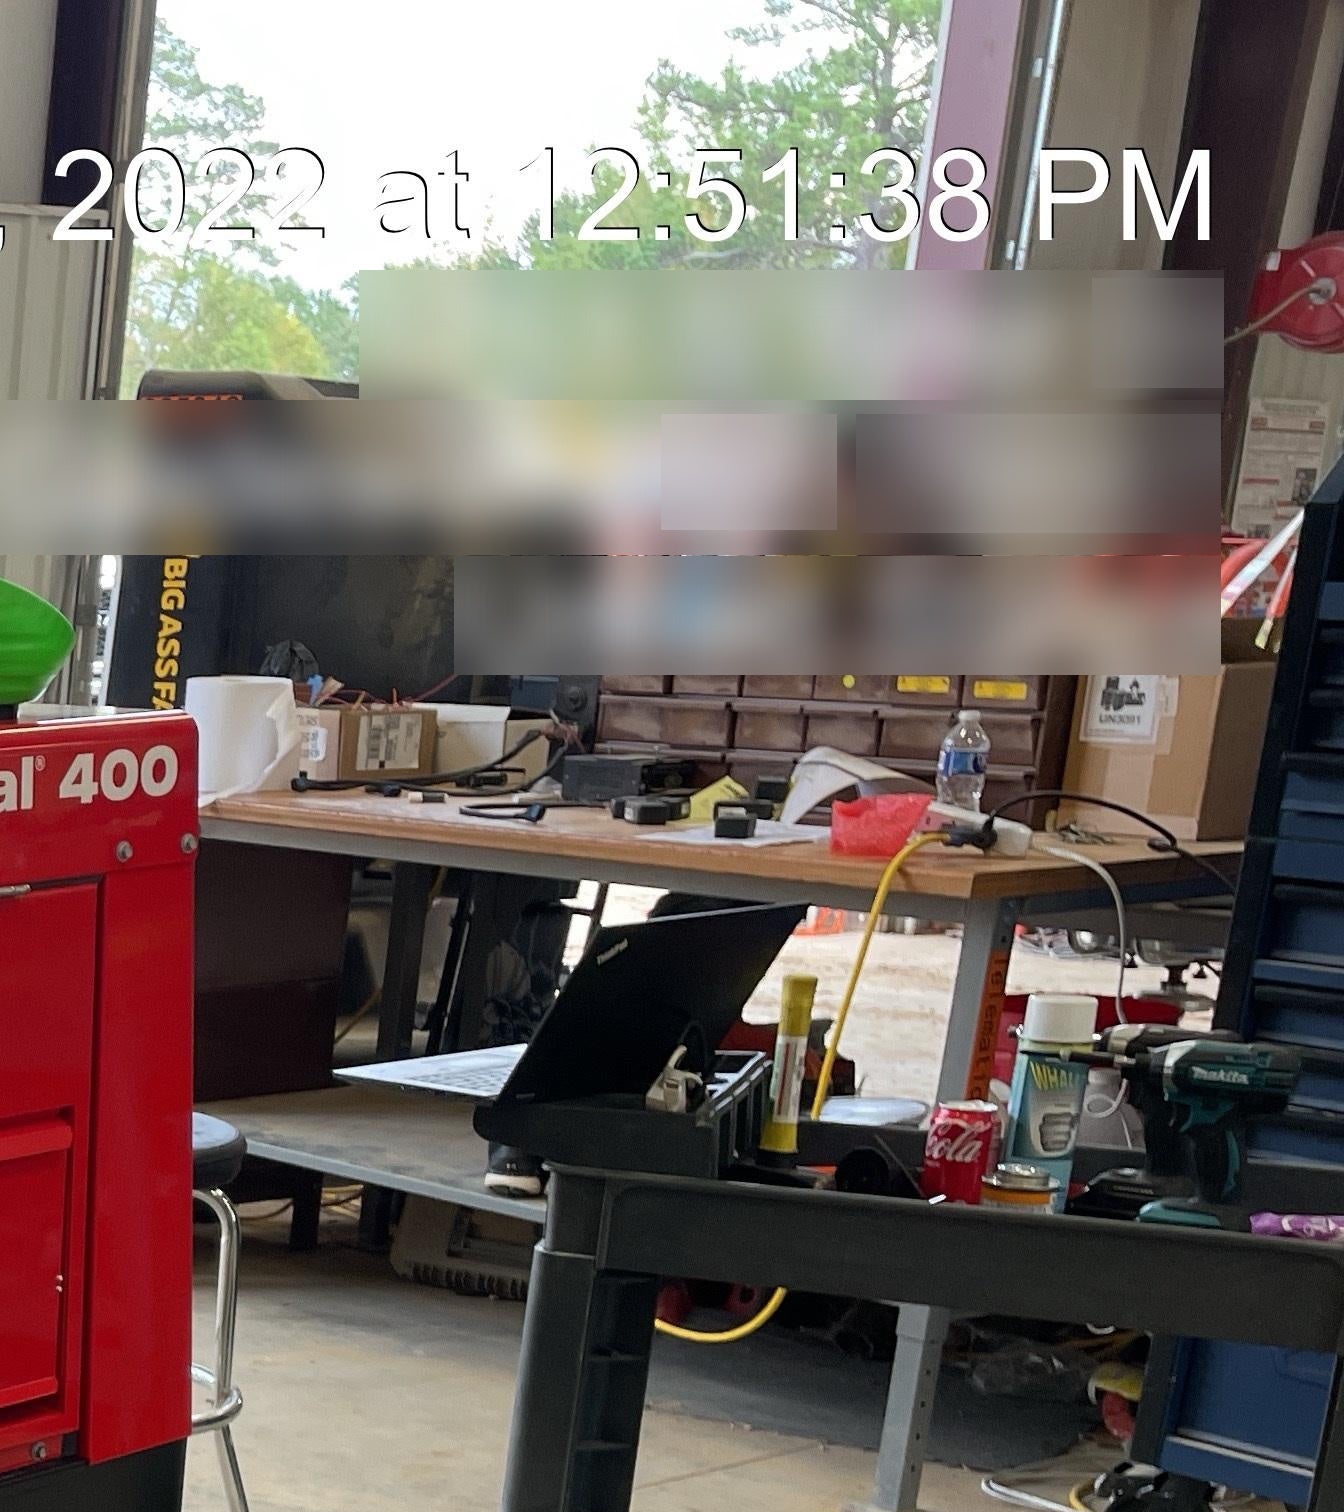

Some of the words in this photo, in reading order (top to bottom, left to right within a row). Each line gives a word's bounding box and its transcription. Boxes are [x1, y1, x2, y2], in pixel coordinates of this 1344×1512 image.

[162, 557, 188, 611] BIG
[154, 613, 183, 678] ASS
[58, 744, 179, 804] 400
